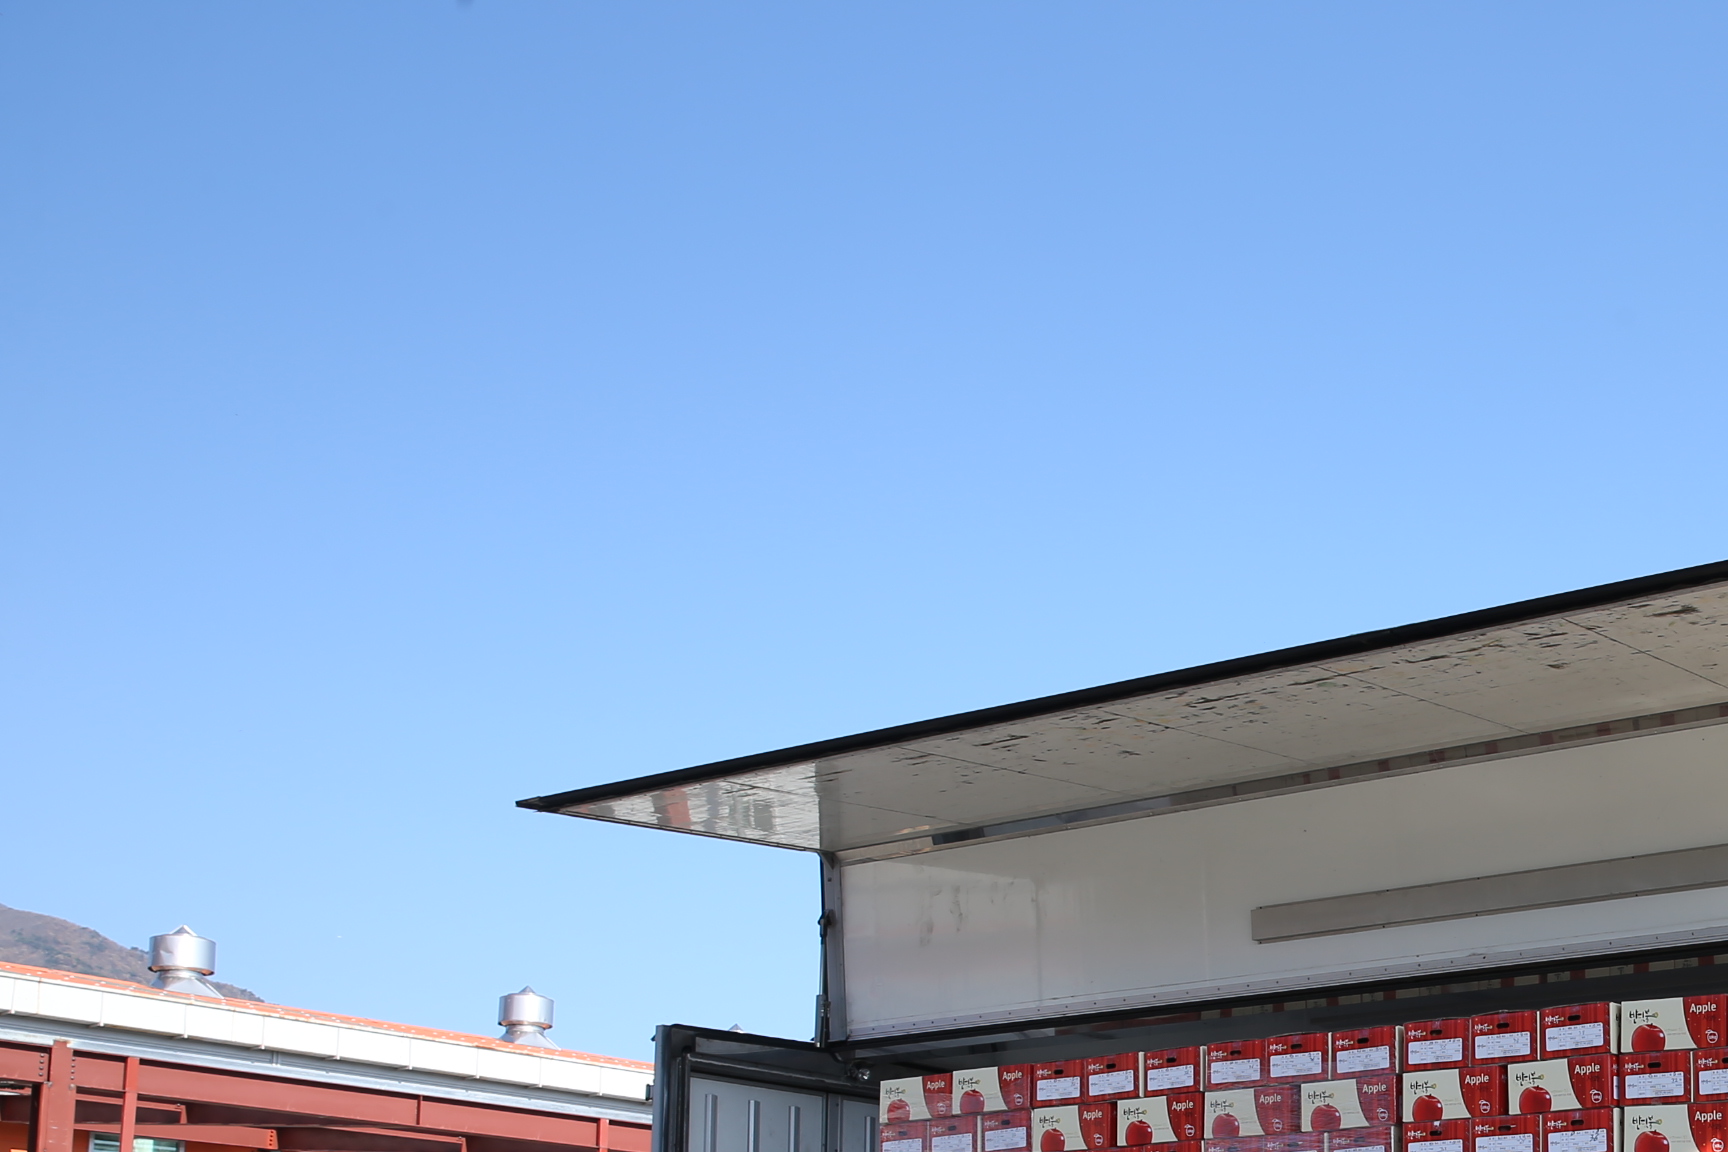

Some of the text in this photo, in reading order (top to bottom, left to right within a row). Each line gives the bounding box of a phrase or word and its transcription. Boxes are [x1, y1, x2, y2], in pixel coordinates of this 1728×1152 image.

[1689, 1002, 1717, 1014] Apple
[1574, 1063, 1600, 1074] Apple
[1002, 1070, 1023, 1080] Apple
[1464, 1073, 1489, 1085] Apple
[926, 1080, 945, 1090] Apple
[1362, 1082, 1387, 1094] Apple
[1259, 1093, 1282, 1105] Apple
[1171, 1100, 1194, 1110] Apple
[1082, 1109, 1103, 1120] Apple
[1694, 1110, 1722, 1122] Apple
